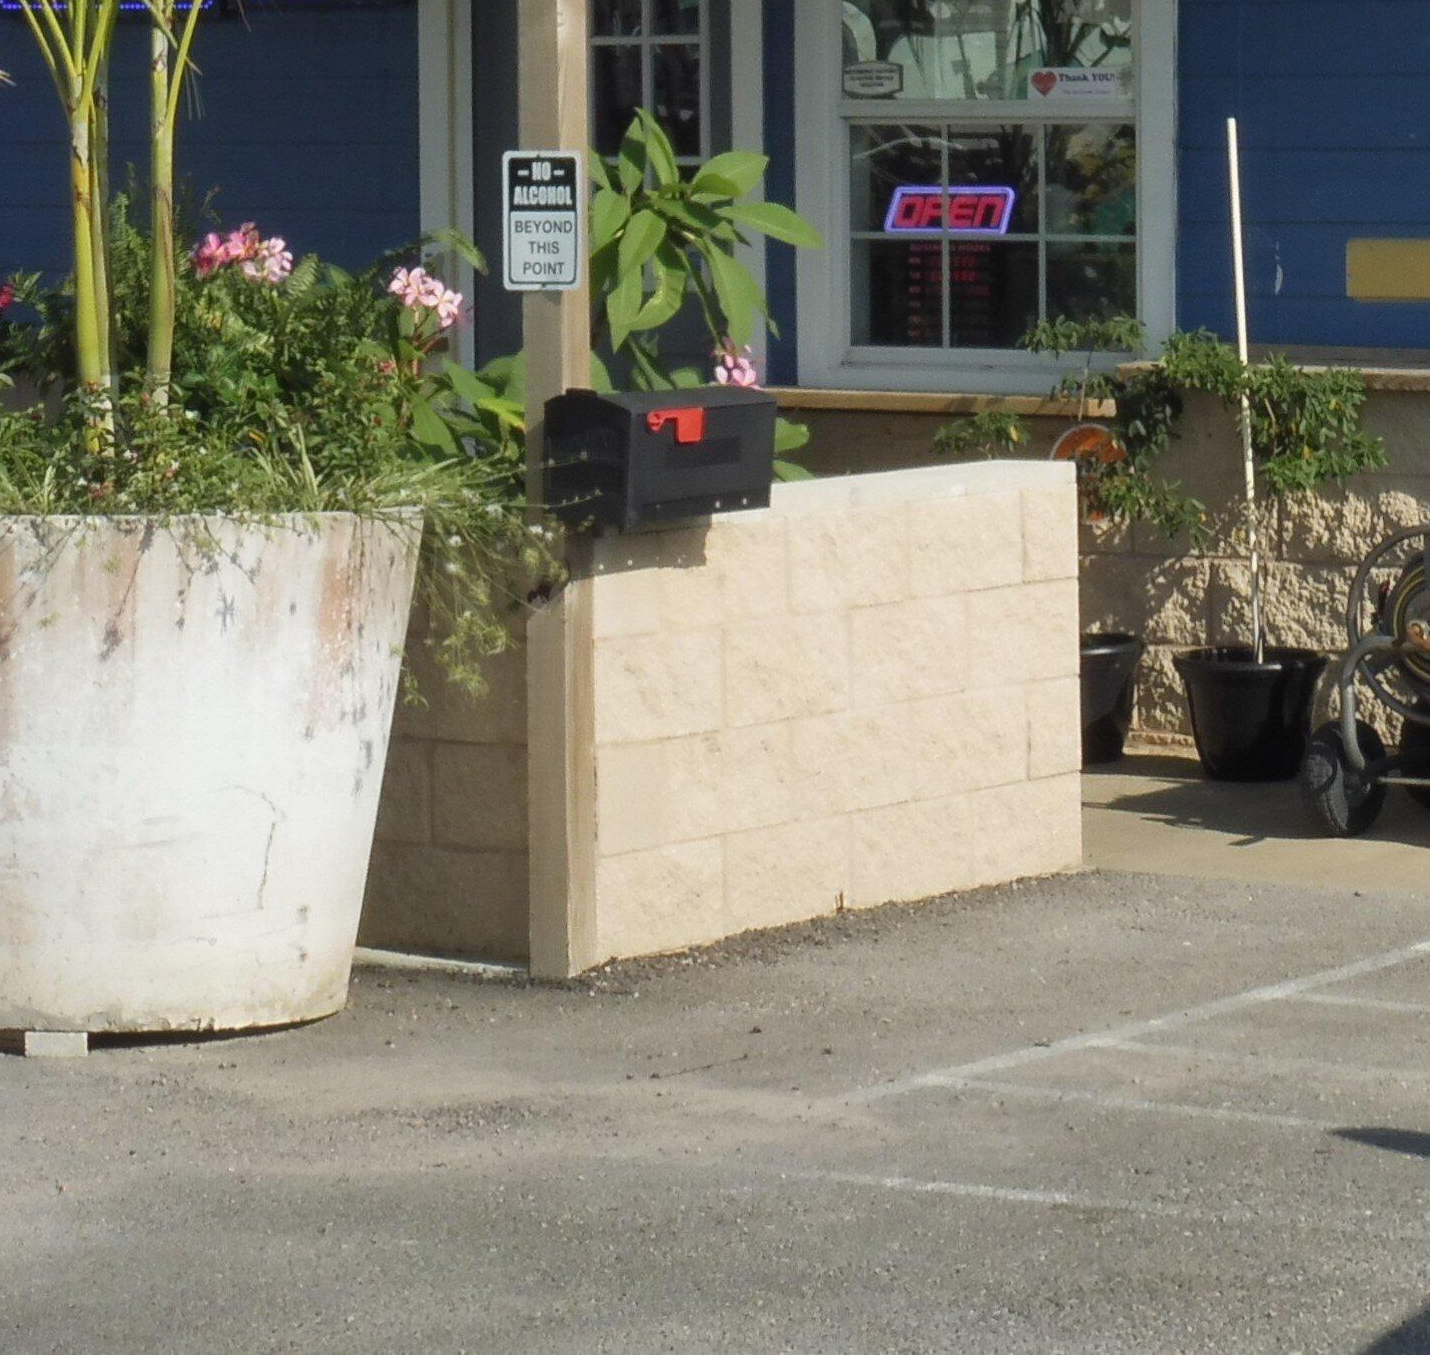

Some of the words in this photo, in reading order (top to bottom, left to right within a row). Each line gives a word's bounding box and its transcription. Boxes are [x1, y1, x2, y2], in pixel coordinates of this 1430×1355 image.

[1059, 73, 1089, 82] Thank
[514, 185, 573, 205] ALCOHOL
[894, 196, 1005, 227] OPEN
[514, 220, 573, 233] BEYOND
[528, 241, 560, 254] THIS
[523, 262, 564, 275] POINT
